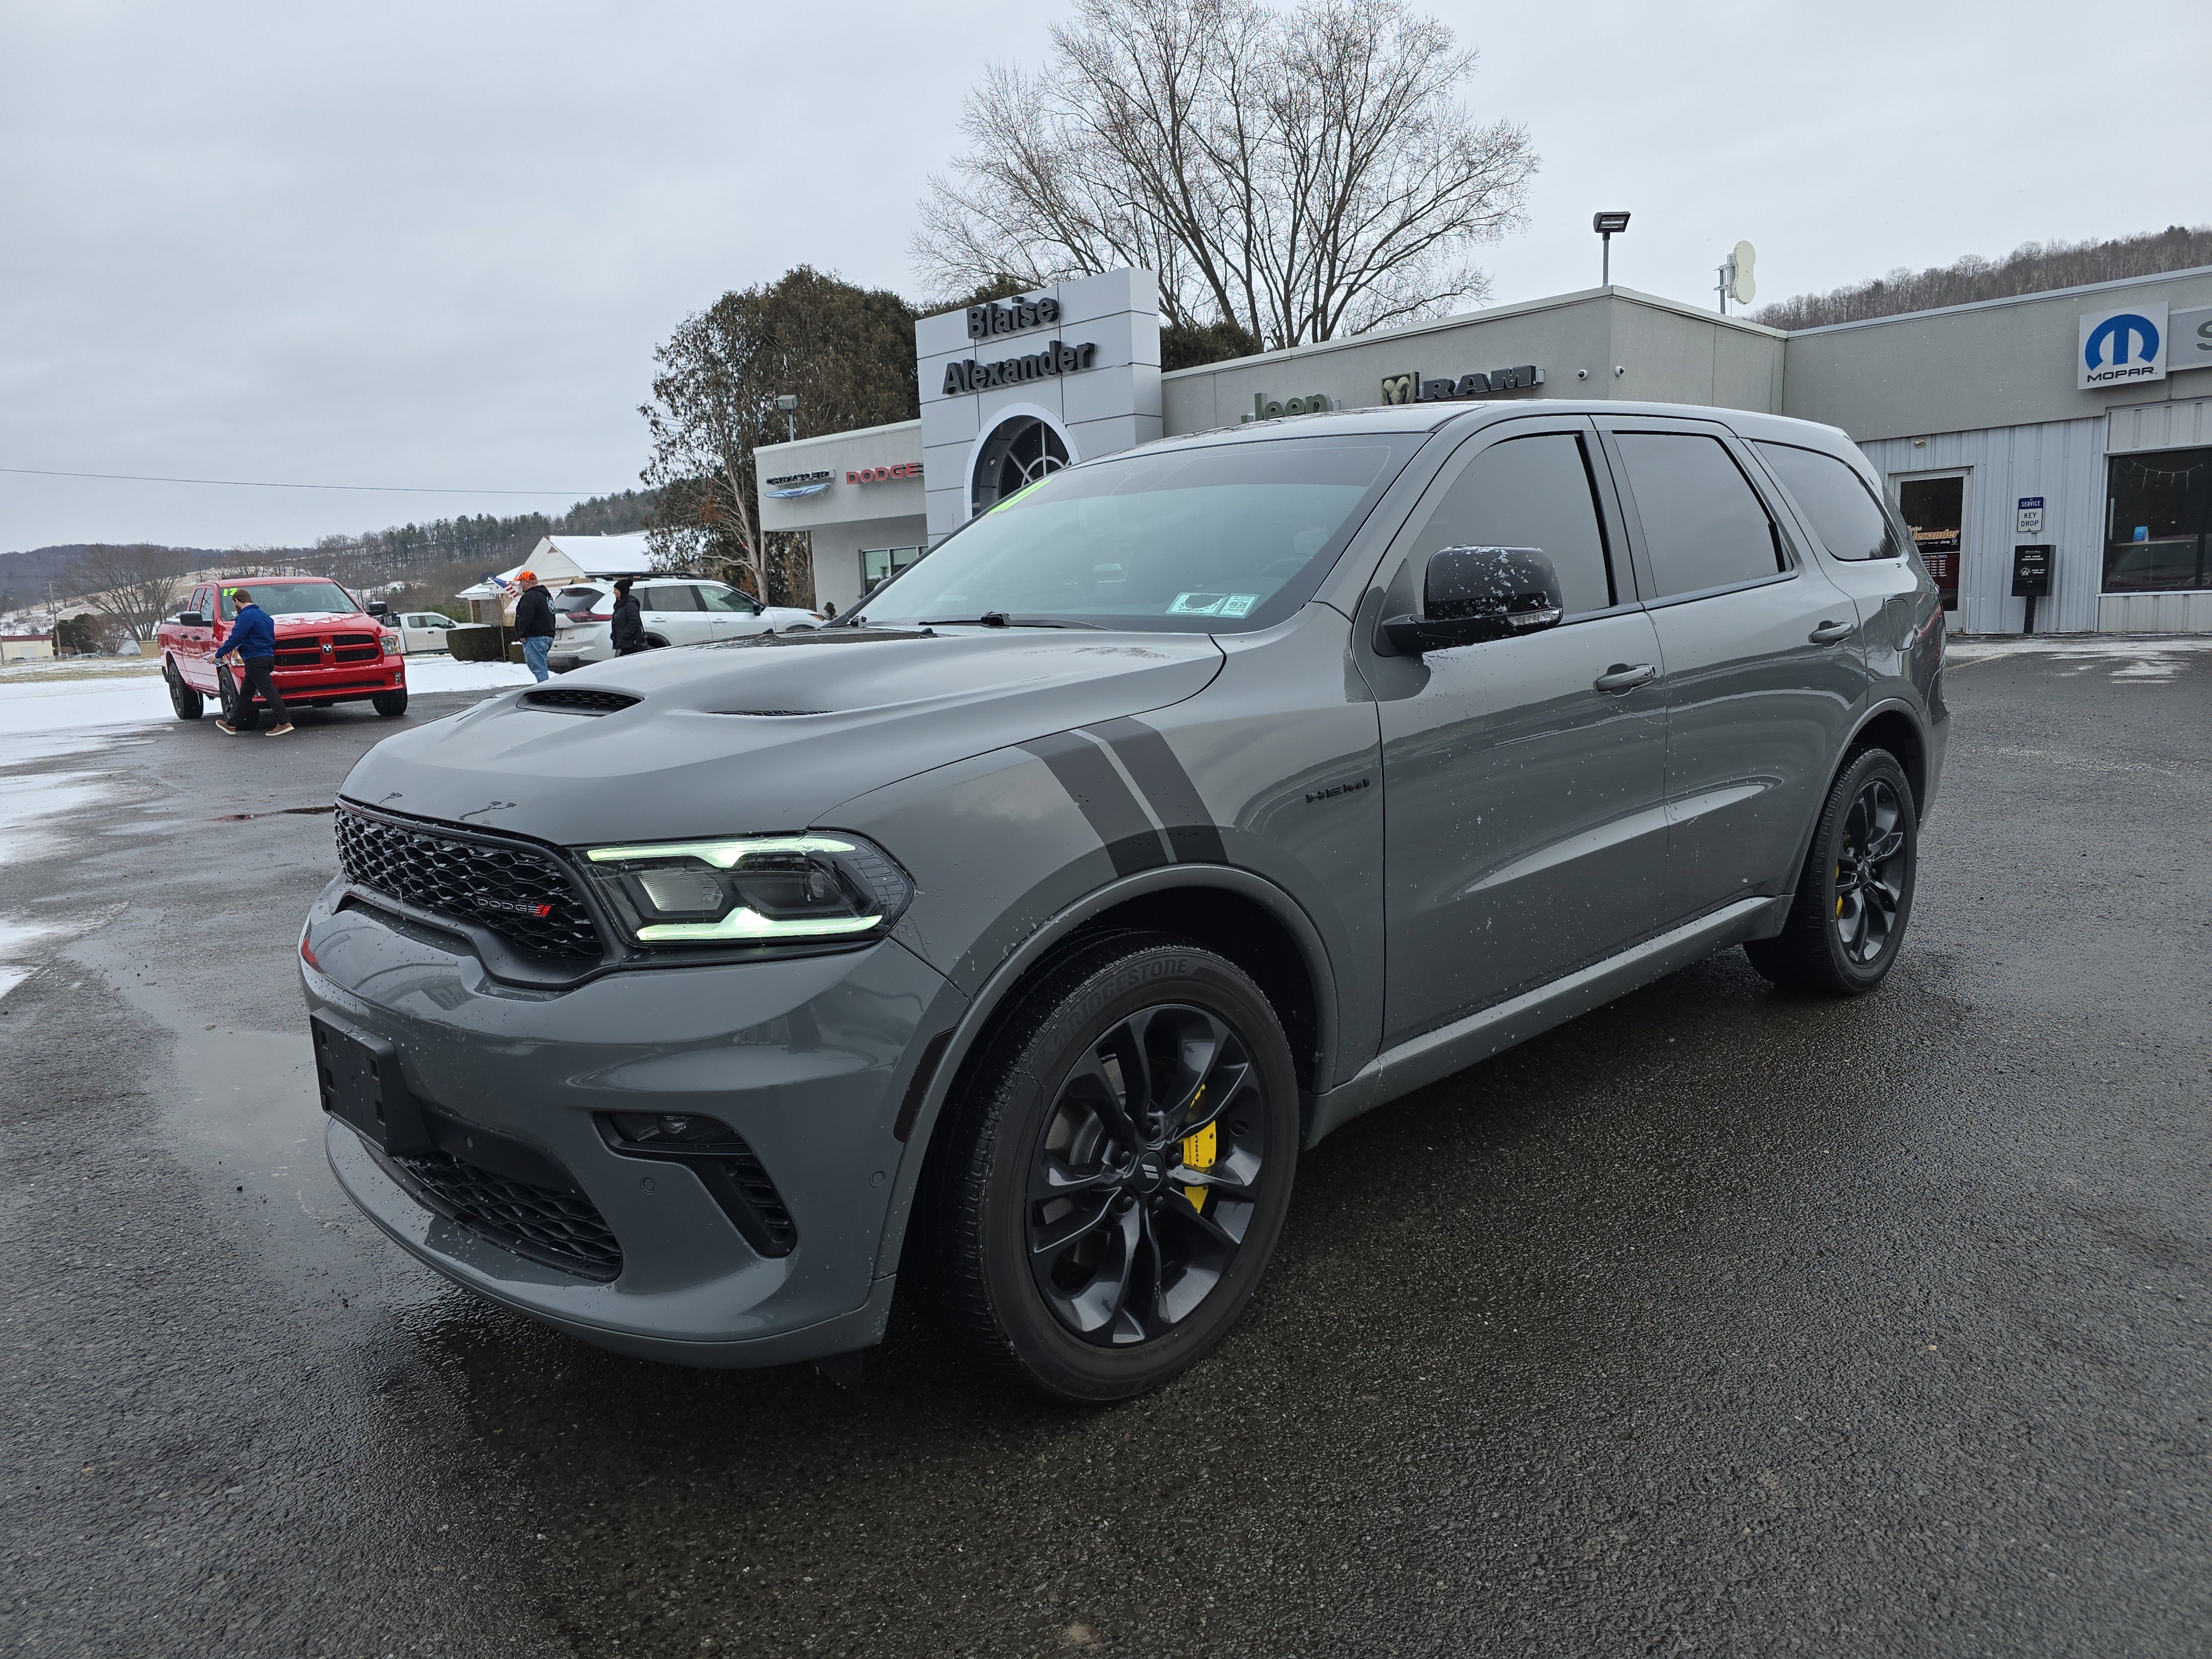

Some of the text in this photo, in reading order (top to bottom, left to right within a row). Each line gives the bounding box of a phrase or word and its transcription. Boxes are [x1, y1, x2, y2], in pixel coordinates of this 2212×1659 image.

[967, 296, 1058, 339] Blaise
[942, 340, 1094, 395] Alexander
[2087, 366, 2154, 382] MOPAR
[1423, 365, 1535, 400] RAM
[846, 462, 921, 484] DODGE
[1912, 529, 1959, 541] lexander
[223, 587, 237, 596] 17
[1306, 779, 1370, 803] HEMI
[477, 898, 541, 914] DODGE
[1056, 958, 1188, 1045] BRIDGESTONE
